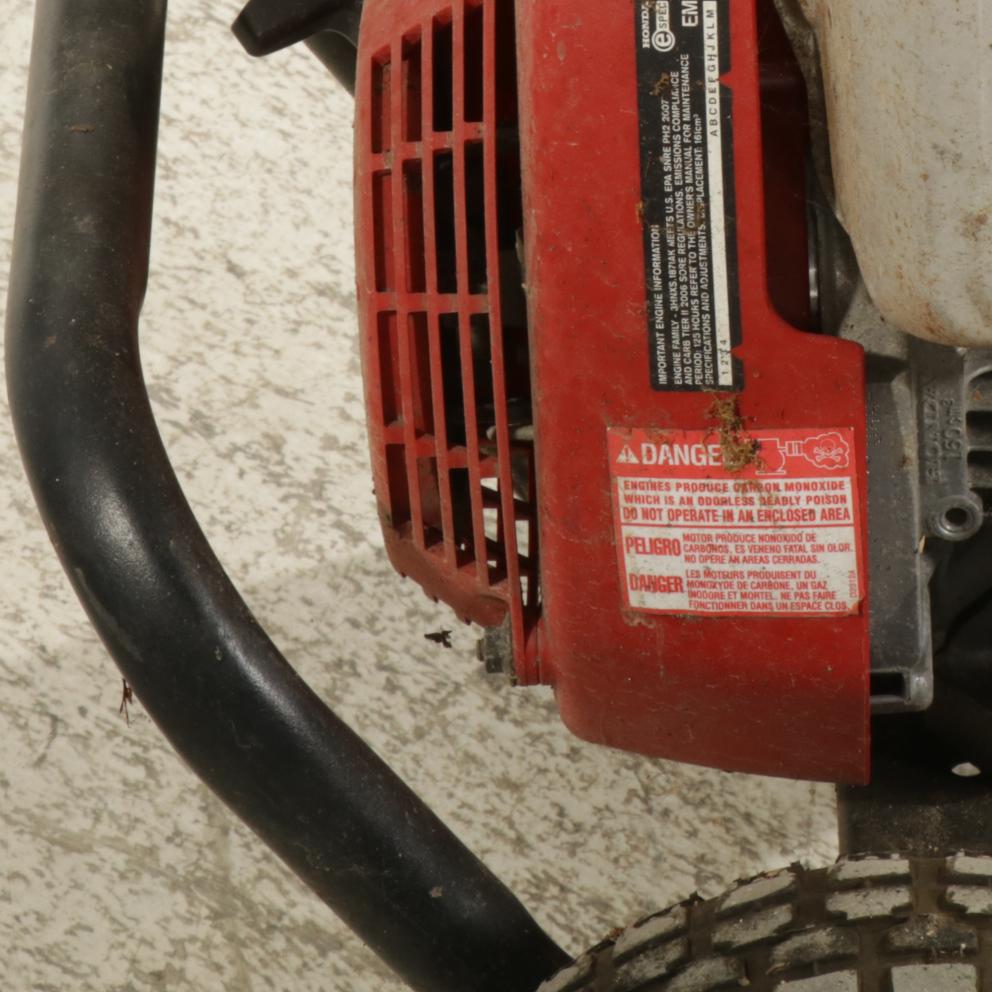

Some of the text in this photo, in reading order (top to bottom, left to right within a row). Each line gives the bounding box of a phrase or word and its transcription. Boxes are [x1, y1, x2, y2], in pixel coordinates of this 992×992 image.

[658, 2, 667, 29] SPEC
[681, 0, 699, 26] EM
[680, 53, 691, 121] MAINTENANCE
[661, 99, 669, 121] 2007
[661, 125, 670, 143] PH2
[683, 123, 692, 142] FOR
[663, 146, 671, 171] SNRE
[673, 134, 683, 185] EMISSIONS
[684, 146, 693, 183] MANUAL
[663, 174, 672, 191] EPA
[664, 194, 673, 212] U.S.
[686, 185, 695, 228] OWNER'S
[666, 215, 675, 246] MEETS
[687, 230, 696, 248] THE
[688, 251, 697, 264] TO
[679, 256, 687, 281] SORE
[690, 266, 698, 296] REFER
[651, 224, 667, 384] IMPORTANT ENGINE INFORMATION
[680, 284, 688, 307] 2006
[691, 299, 700, 330] HOURS
[671, 319, 680, 349] FAMILY
[682, 317, 690, 336] TIER
[692, 332, 701, 347] 125
[702, 313, 713, 384] SPECIFICATIONS
[683, 339, 691, 364] CARB
[673, 351, 682, 384] ENGINE
[683, 366, 693, 384] AND
[641, 442, 724, 467] DANGE
[623, 480, 671, 491] ENGINES
[675, 482, 729, 493] PRODUCE
[784, 480, 845, 492] MONOXIDE
[624, 494, 848, 506] WHICH IS AN ODORLESS DEADLY POISON
[623, 506, 851, 522] DO NOT OPERATE IN AN ENCLOSED AREA
[625, 536, 682, 557] PELIGRO
[682, 533, 713, 543] MOTOR
[715, 533, 756, 543] PRODUCE
[805, 532, 817, 543] DE
[684, 554, 697, 564] NO
[700, 554, 726, 564] OPERE
[742, 555, 769, 564] AREAS
[735, 544, 746, 554] ES
[748, 543, 781, 553] VENENO
[784, 543, 808, 553] FATAL
[810, 543, 825, 553] SIN
[629, 572, 685, 594] DANGER
[685, 569, 817, 580] LES MOTEURS PRODUISENT DU
[687, 579, 735, 589] MONOXYDE
[737, 581, 748, 590] DE
[796, 580, 809, 590] UN
[811, 580, 828, 590] GAZ
[689, 600, 747, 610] FONCTIONNER
[750, 601, 773, 611] DANS
[776, 601, 788, 610] UN
[791, 601, 823, 611] ESPACE
[728, 591, 738, 600] ET
[780, 591, 792, 601] NE
[794, 591, 811, 601] PAS
[812, 591, 837, 601] FAIRE
